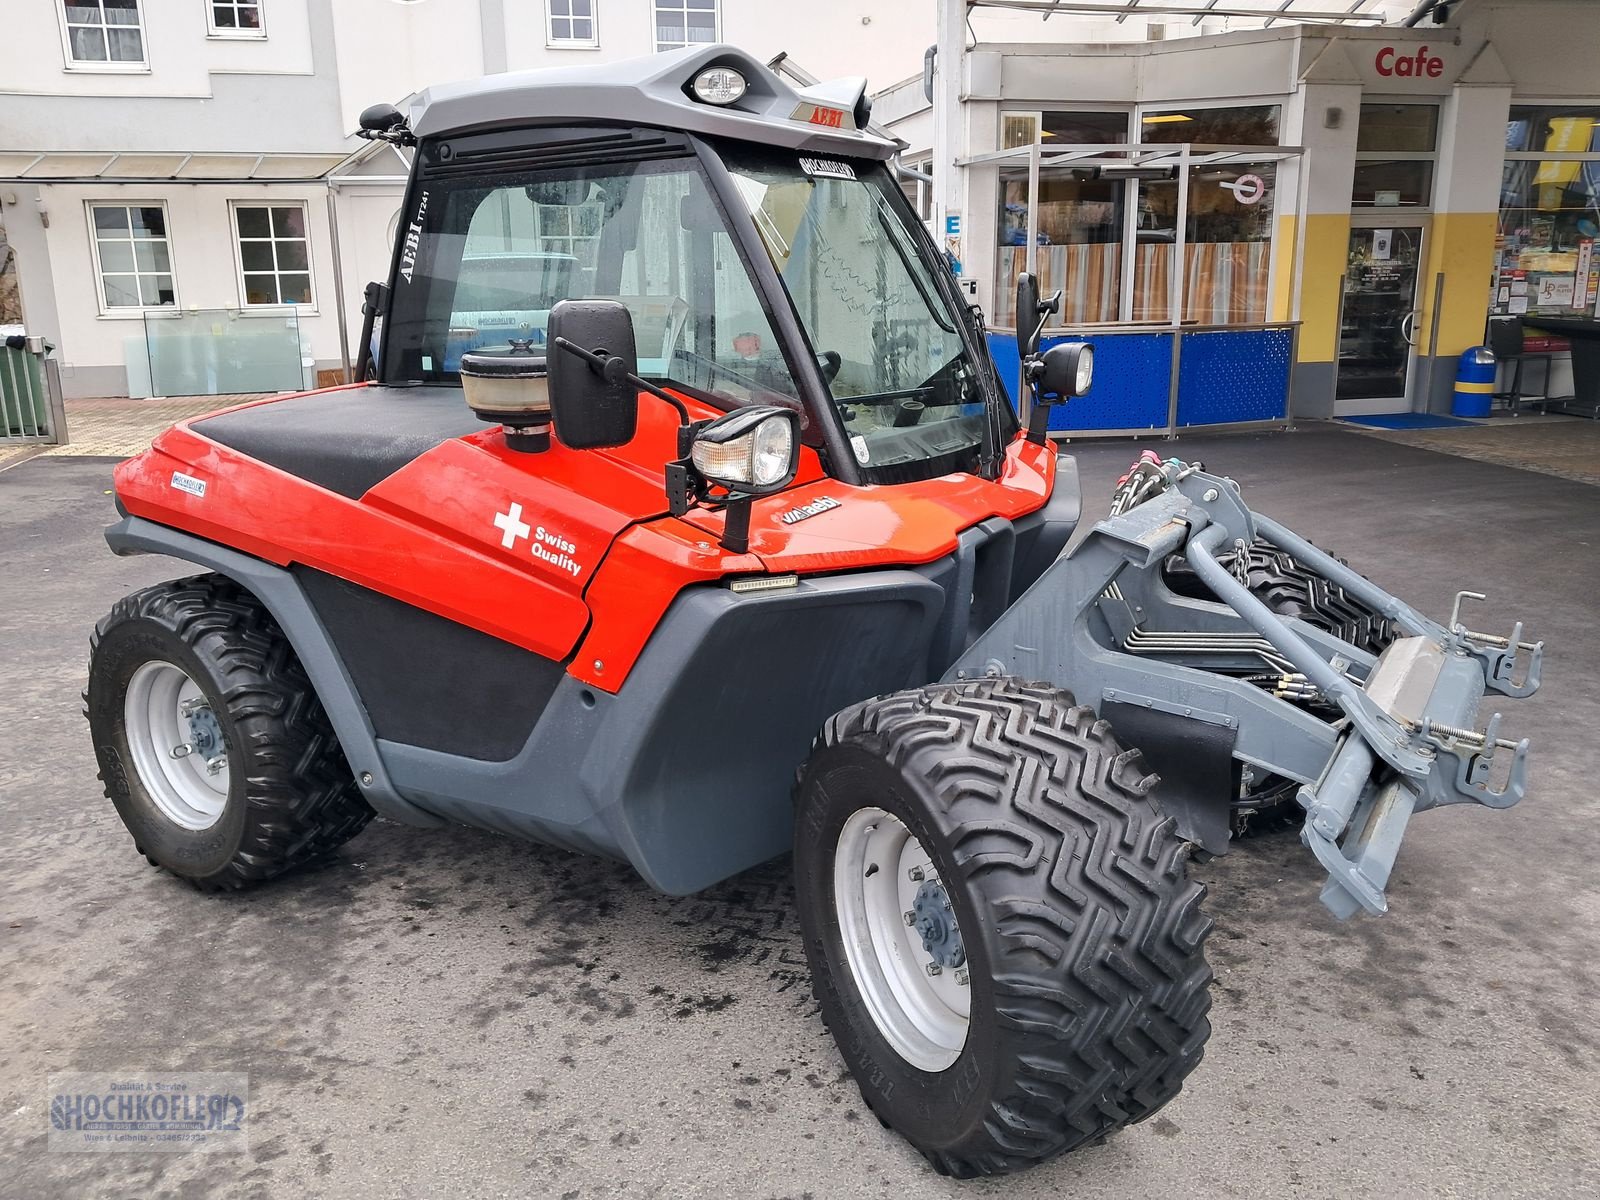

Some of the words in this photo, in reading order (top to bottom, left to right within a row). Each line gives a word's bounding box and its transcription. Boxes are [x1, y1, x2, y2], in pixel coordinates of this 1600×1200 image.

[1375, 46, 1444, 78] Cafe
[809, 106, 844, 128] AEBI
[400, 221, 422, 285] AEBI
[417, 191, 430, 221] TT241
[535, 526, 576, 554] Swiss
[531, 542, 582, 577] Quality
